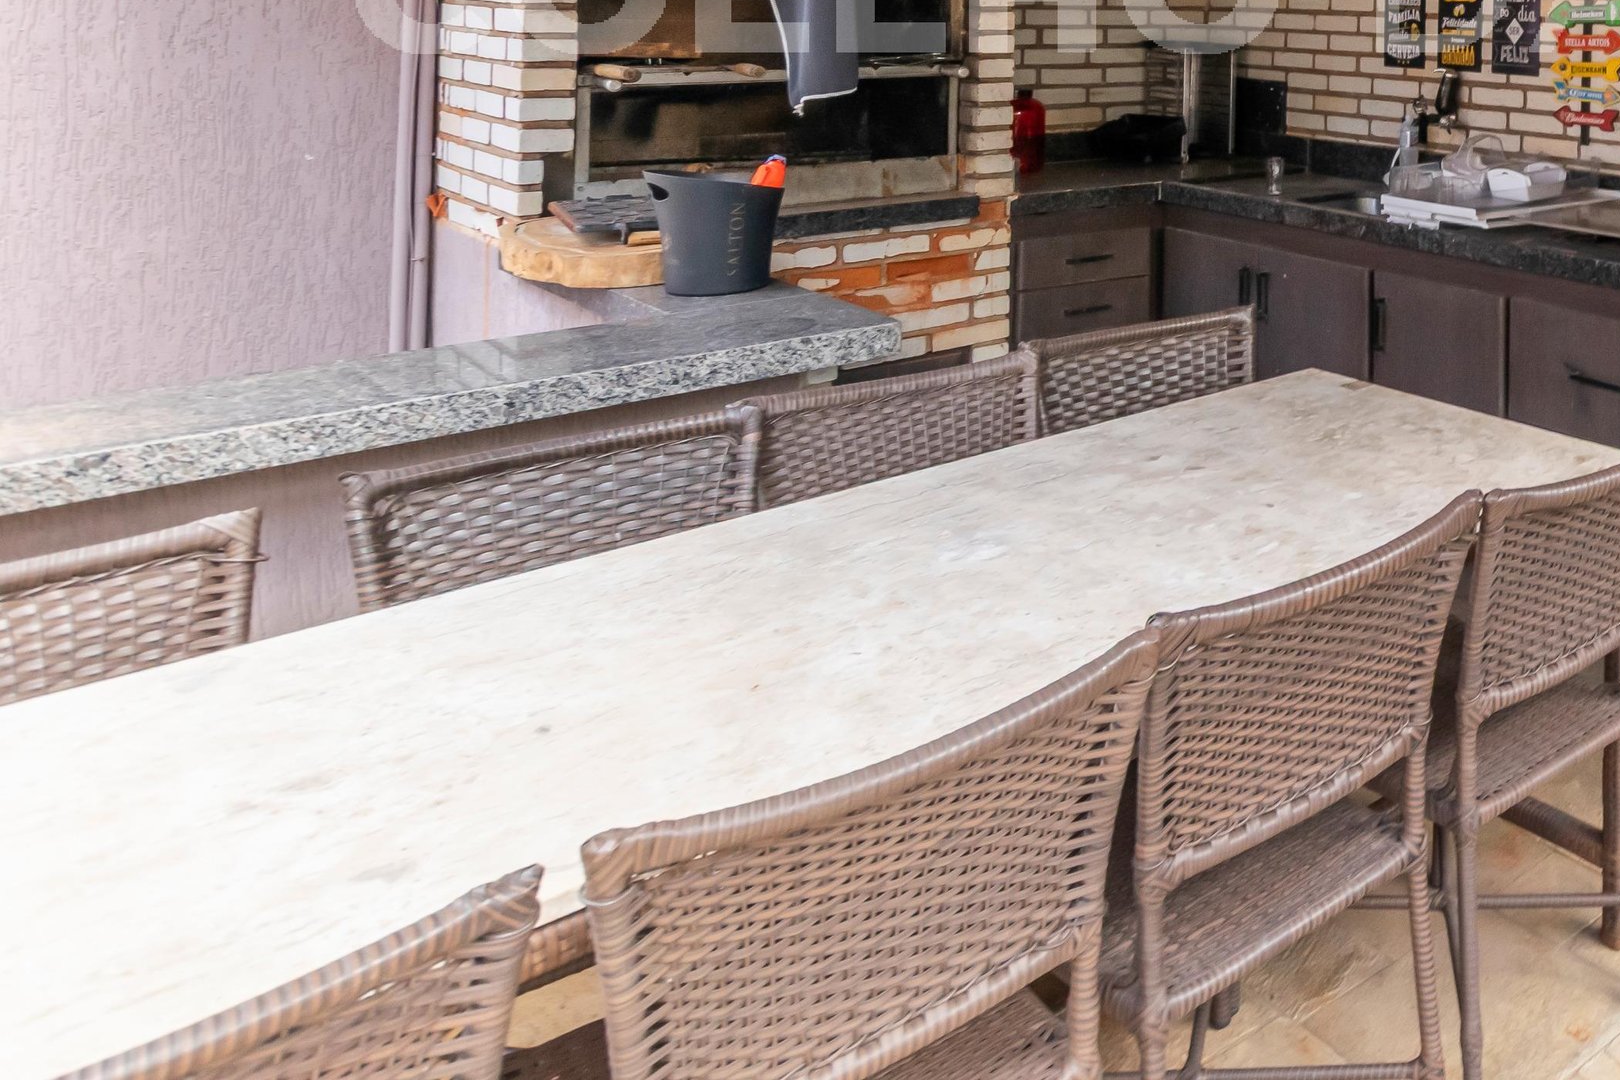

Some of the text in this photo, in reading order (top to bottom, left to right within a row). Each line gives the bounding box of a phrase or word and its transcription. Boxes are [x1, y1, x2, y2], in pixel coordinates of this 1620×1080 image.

[1518, 4, 1537, 23] dia
[1565, 38, 1586, 47] STELLA
[1500, 45, 1530, 64] FELIZ
[727, 202, 746, 277] SALTON
